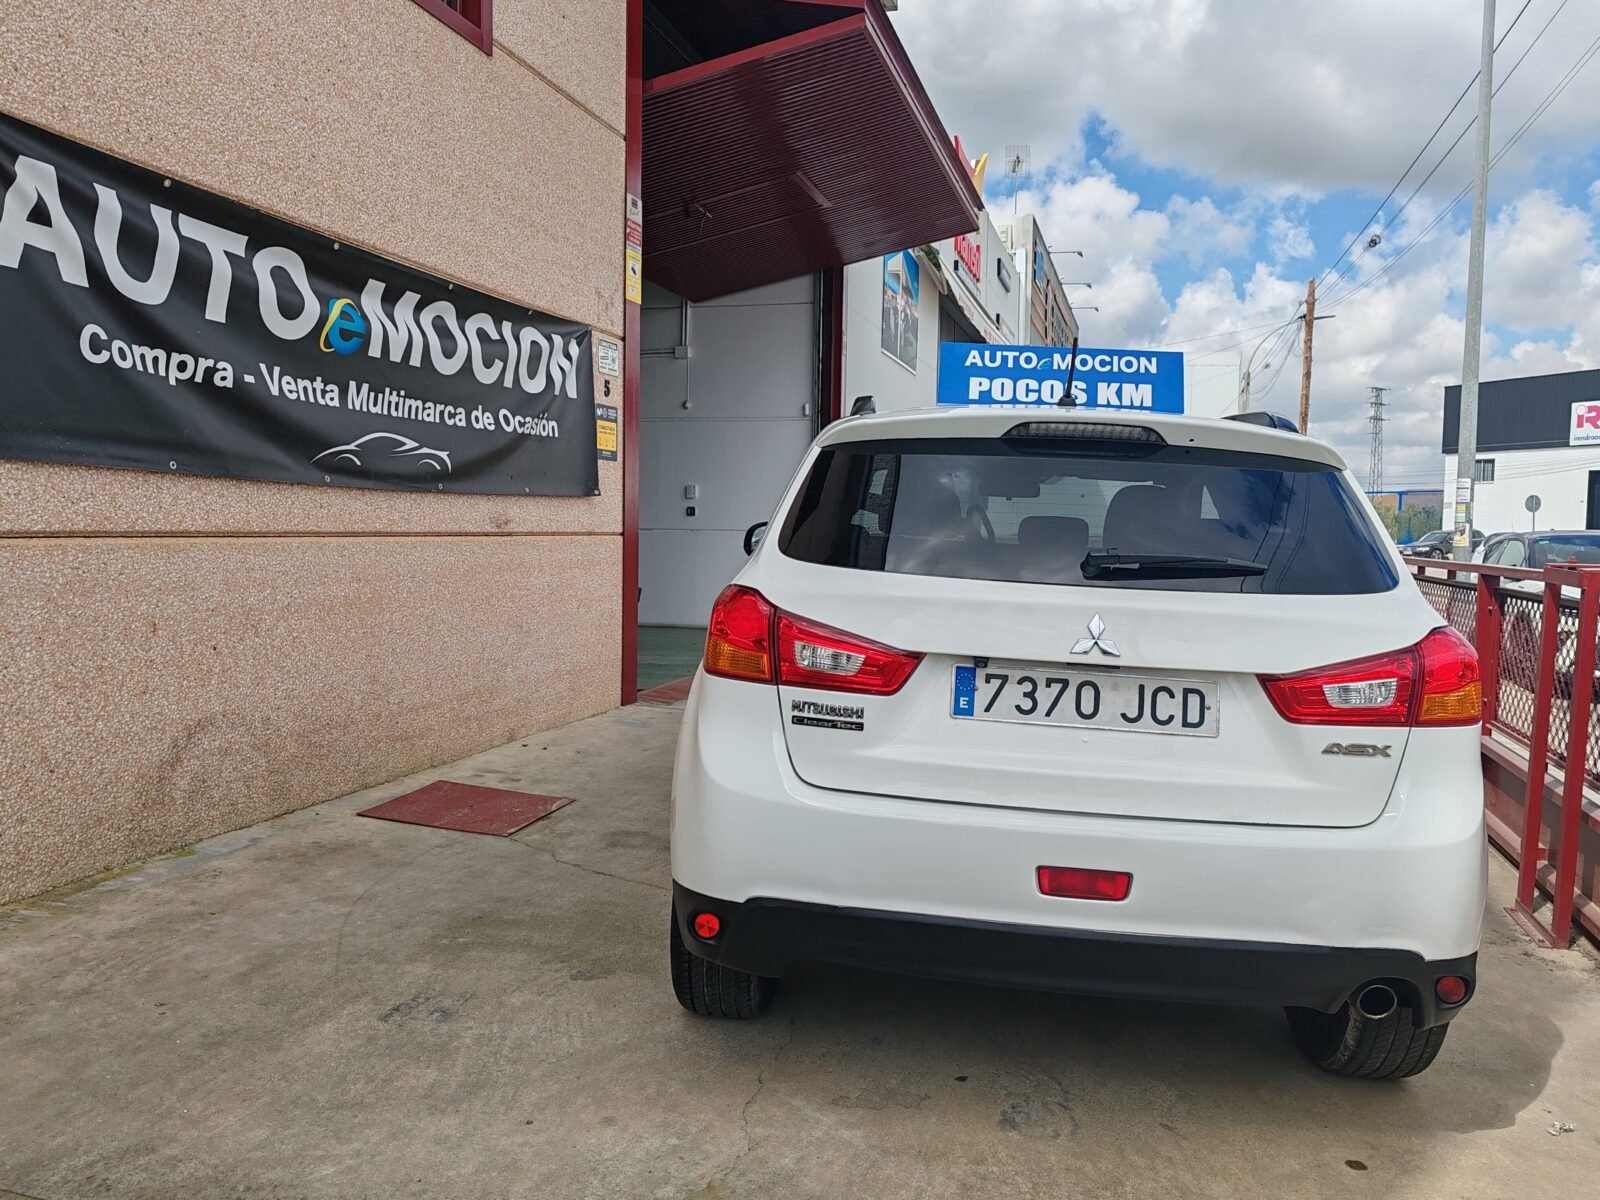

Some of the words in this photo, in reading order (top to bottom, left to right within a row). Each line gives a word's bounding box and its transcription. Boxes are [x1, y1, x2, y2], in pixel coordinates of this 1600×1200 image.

[79, 324, 234, 387] Compra
[258, 362, 340, 408] Venta
[347, 380, 466, 428] Multimarca
[470, 404, 496, 430] de
[499, 409, 559, 438] Ocasión
[603, 379, 611, 398] 5
[968, 376, 1088, 405] POCOS
[1096, 382, 1153, 407] KM
[791, 699, 865, 720] MITSUBISHI
[959, 697, 969, 709] E
[983, 673, 1101, 721] 7370
[1120, 684, 1207, 729] JCD
[792, 716, 863, 731] ClearTec
[1321, 742, 1393, 758] ASX
